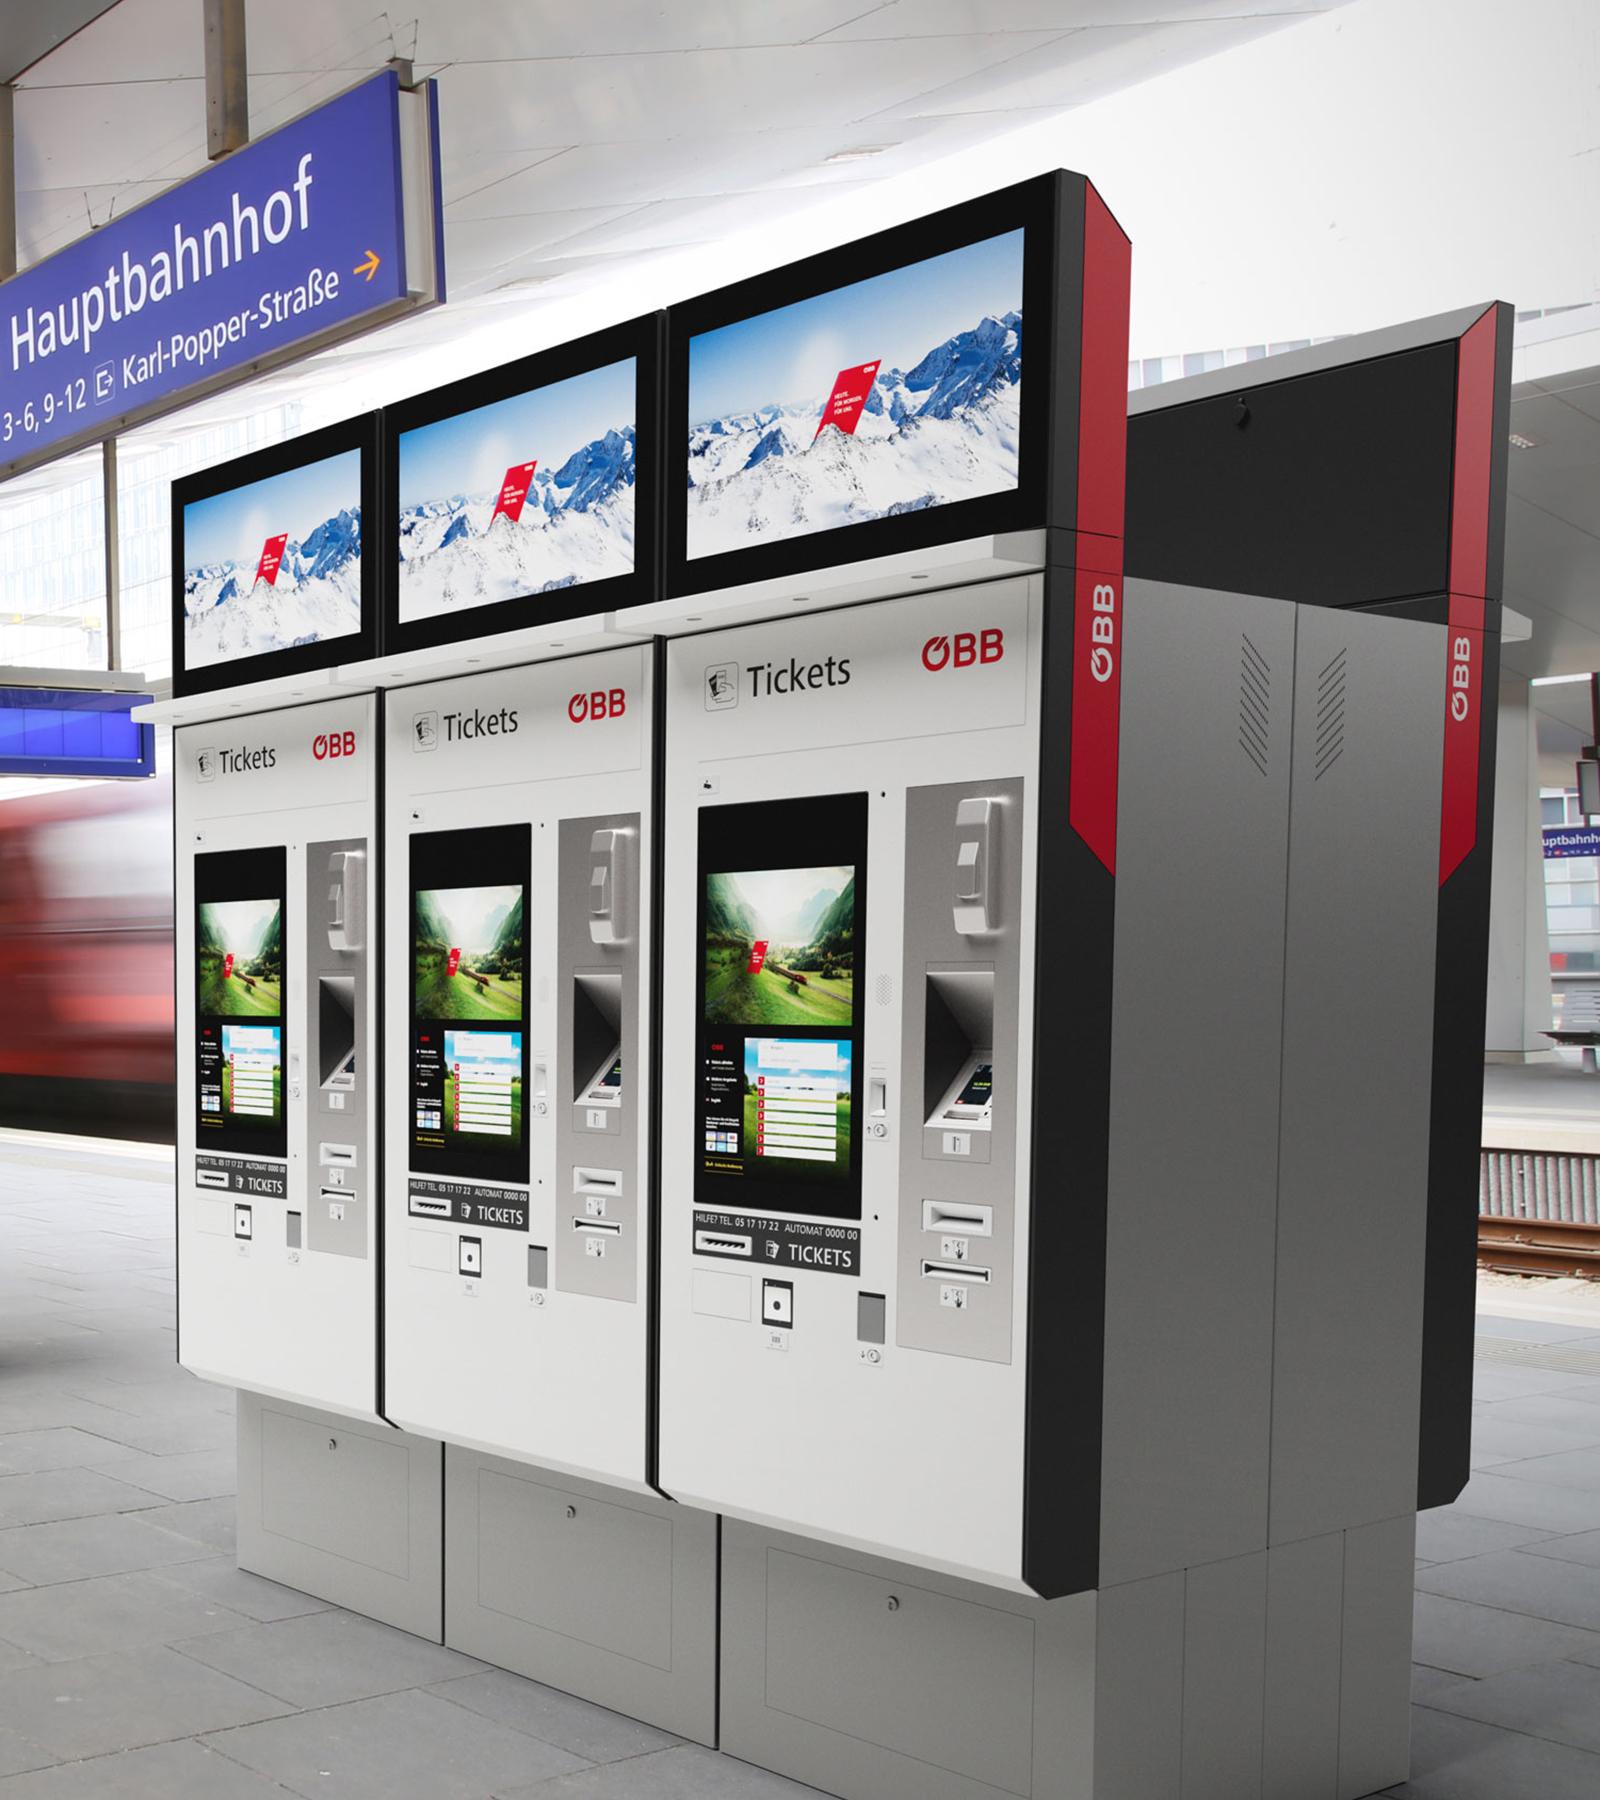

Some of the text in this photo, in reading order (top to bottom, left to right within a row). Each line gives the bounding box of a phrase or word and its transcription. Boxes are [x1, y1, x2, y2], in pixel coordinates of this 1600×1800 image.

[11, 153, 313, 371] Hauptbahnhof
[122, 268, 340, 389] Karl-Popper-Straße
[1090, 584, 1114, 682] ÖBB
[747, 628, 1004, 697] Tickets ÖBB
[1451, 637, 1470, 721] ÖBB
[443, 688, 625, 741] Tickets ÖBB
[219, 731, 355, 774] Tickets ÖBB
[248, 1177, 283, 1194] TICKETS
[477, 1205, 524, 1225] TICKETS
[695, 1213, 718, 1224] HILFE?
[735, 1217, 744, 1227] 05
[747, 1219, 755, 1228] 17
[758, 1220, 767, 1230] 17
[768, 1221, 779, 1231] 22
[784, 1224, 823, 1236] AUTOMAT
[825, 1228, 845, 1239] 0000
[847, 1230, 858, 1240] 00
[788, 1243, 852, 1268] TICKETS
